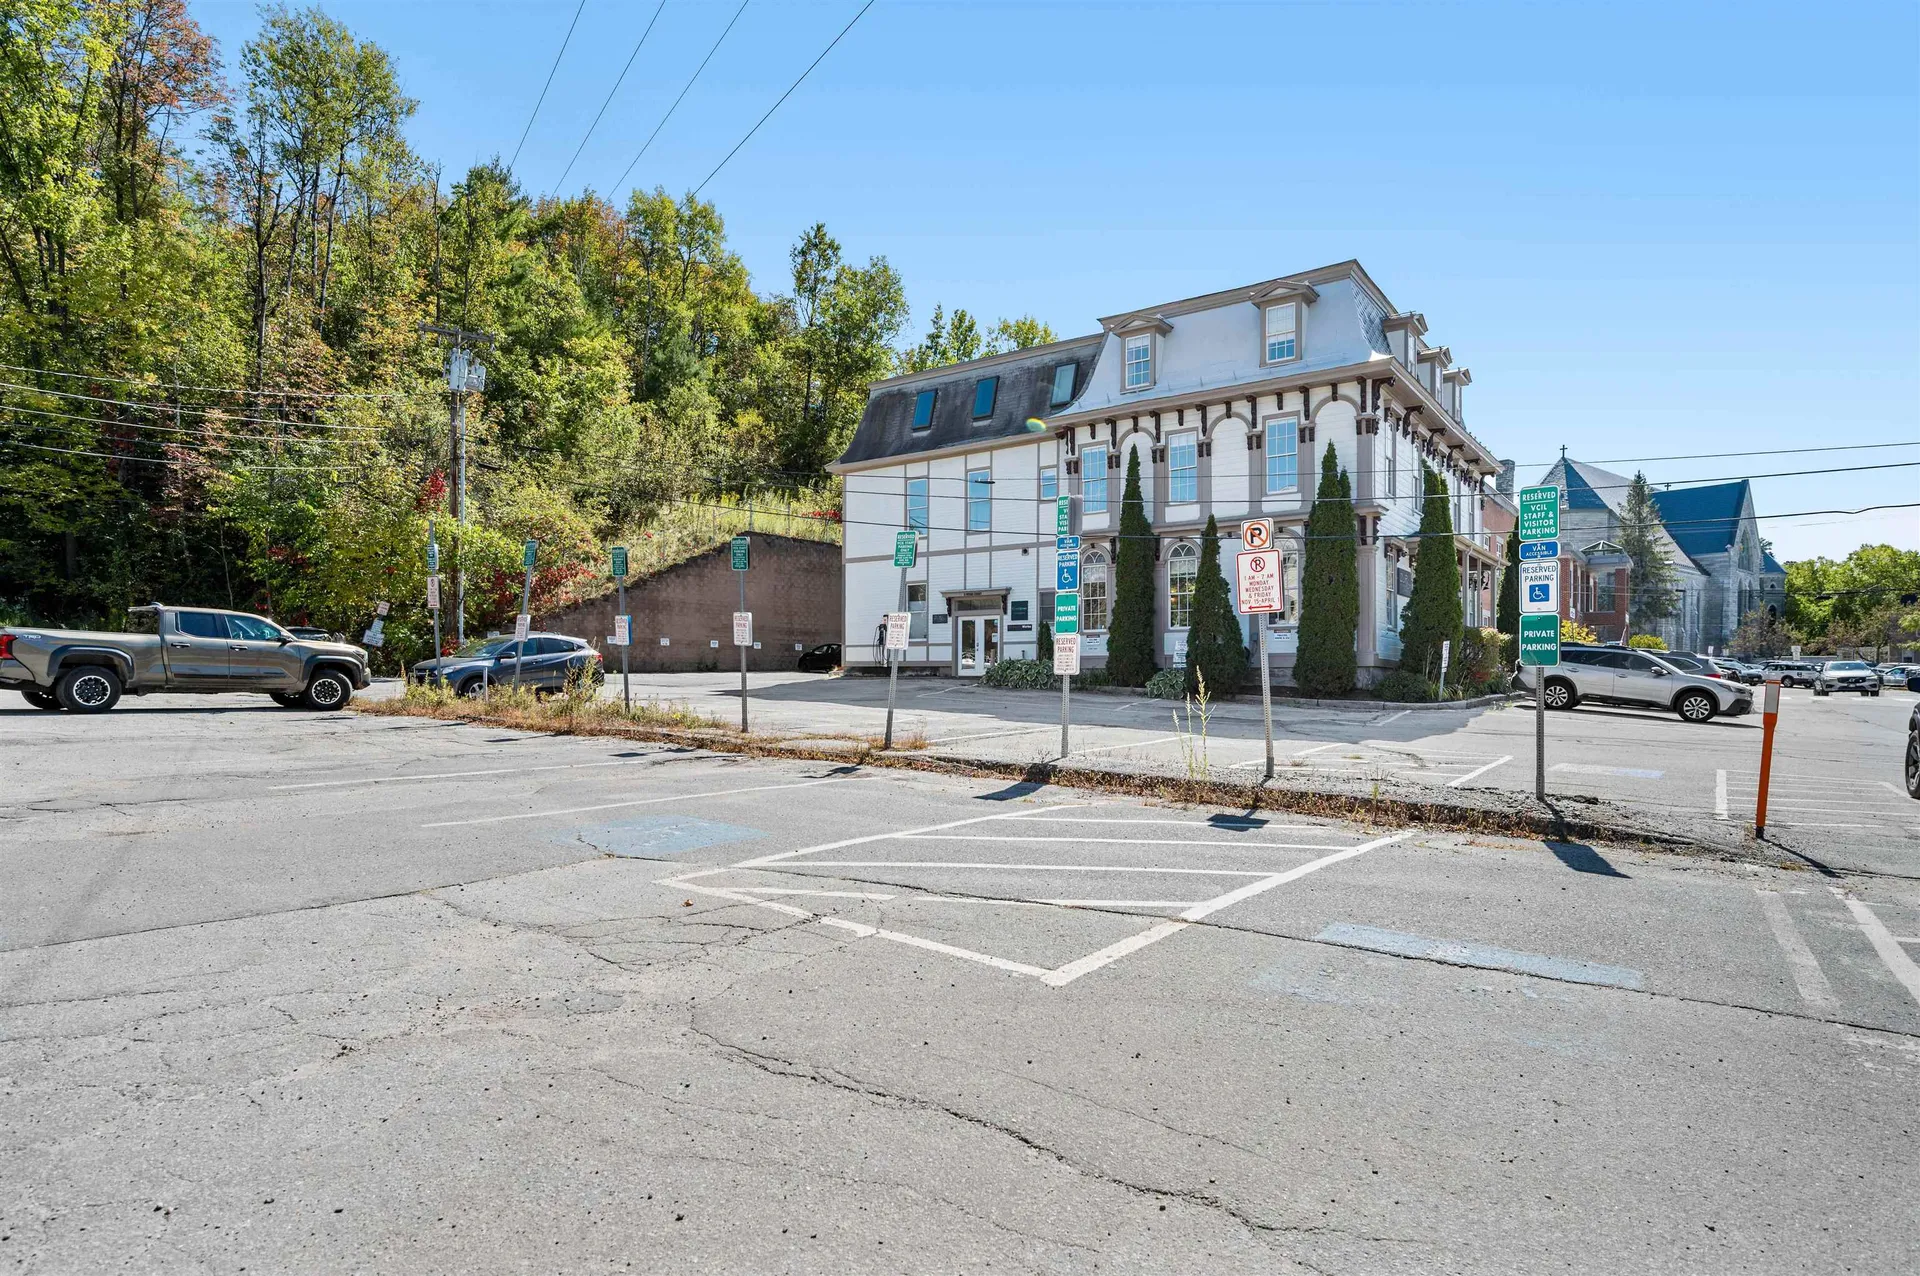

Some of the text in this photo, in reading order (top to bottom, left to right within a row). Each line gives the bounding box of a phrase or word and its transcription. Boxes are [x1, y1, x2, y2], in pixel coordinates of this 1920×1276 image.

[1522, 491, 1556, 501] RESERVED
[1523, 511, 1545, 520] STAFF
[1524, 519, 1554, 527] VISITOR
[1522, 527, 1556, 535] PARKING
[1057, 553, 1078, 561] RESERVED
[1522, 565, 1557, 574] RESERVED
[1524, 574, 1554, 582] PARKING
[1524, 630, 1555, 638] PRIVATE
[1056, 637, 1076, 645] RESERVED
[1522, 643, 1557, 651] PARKING
